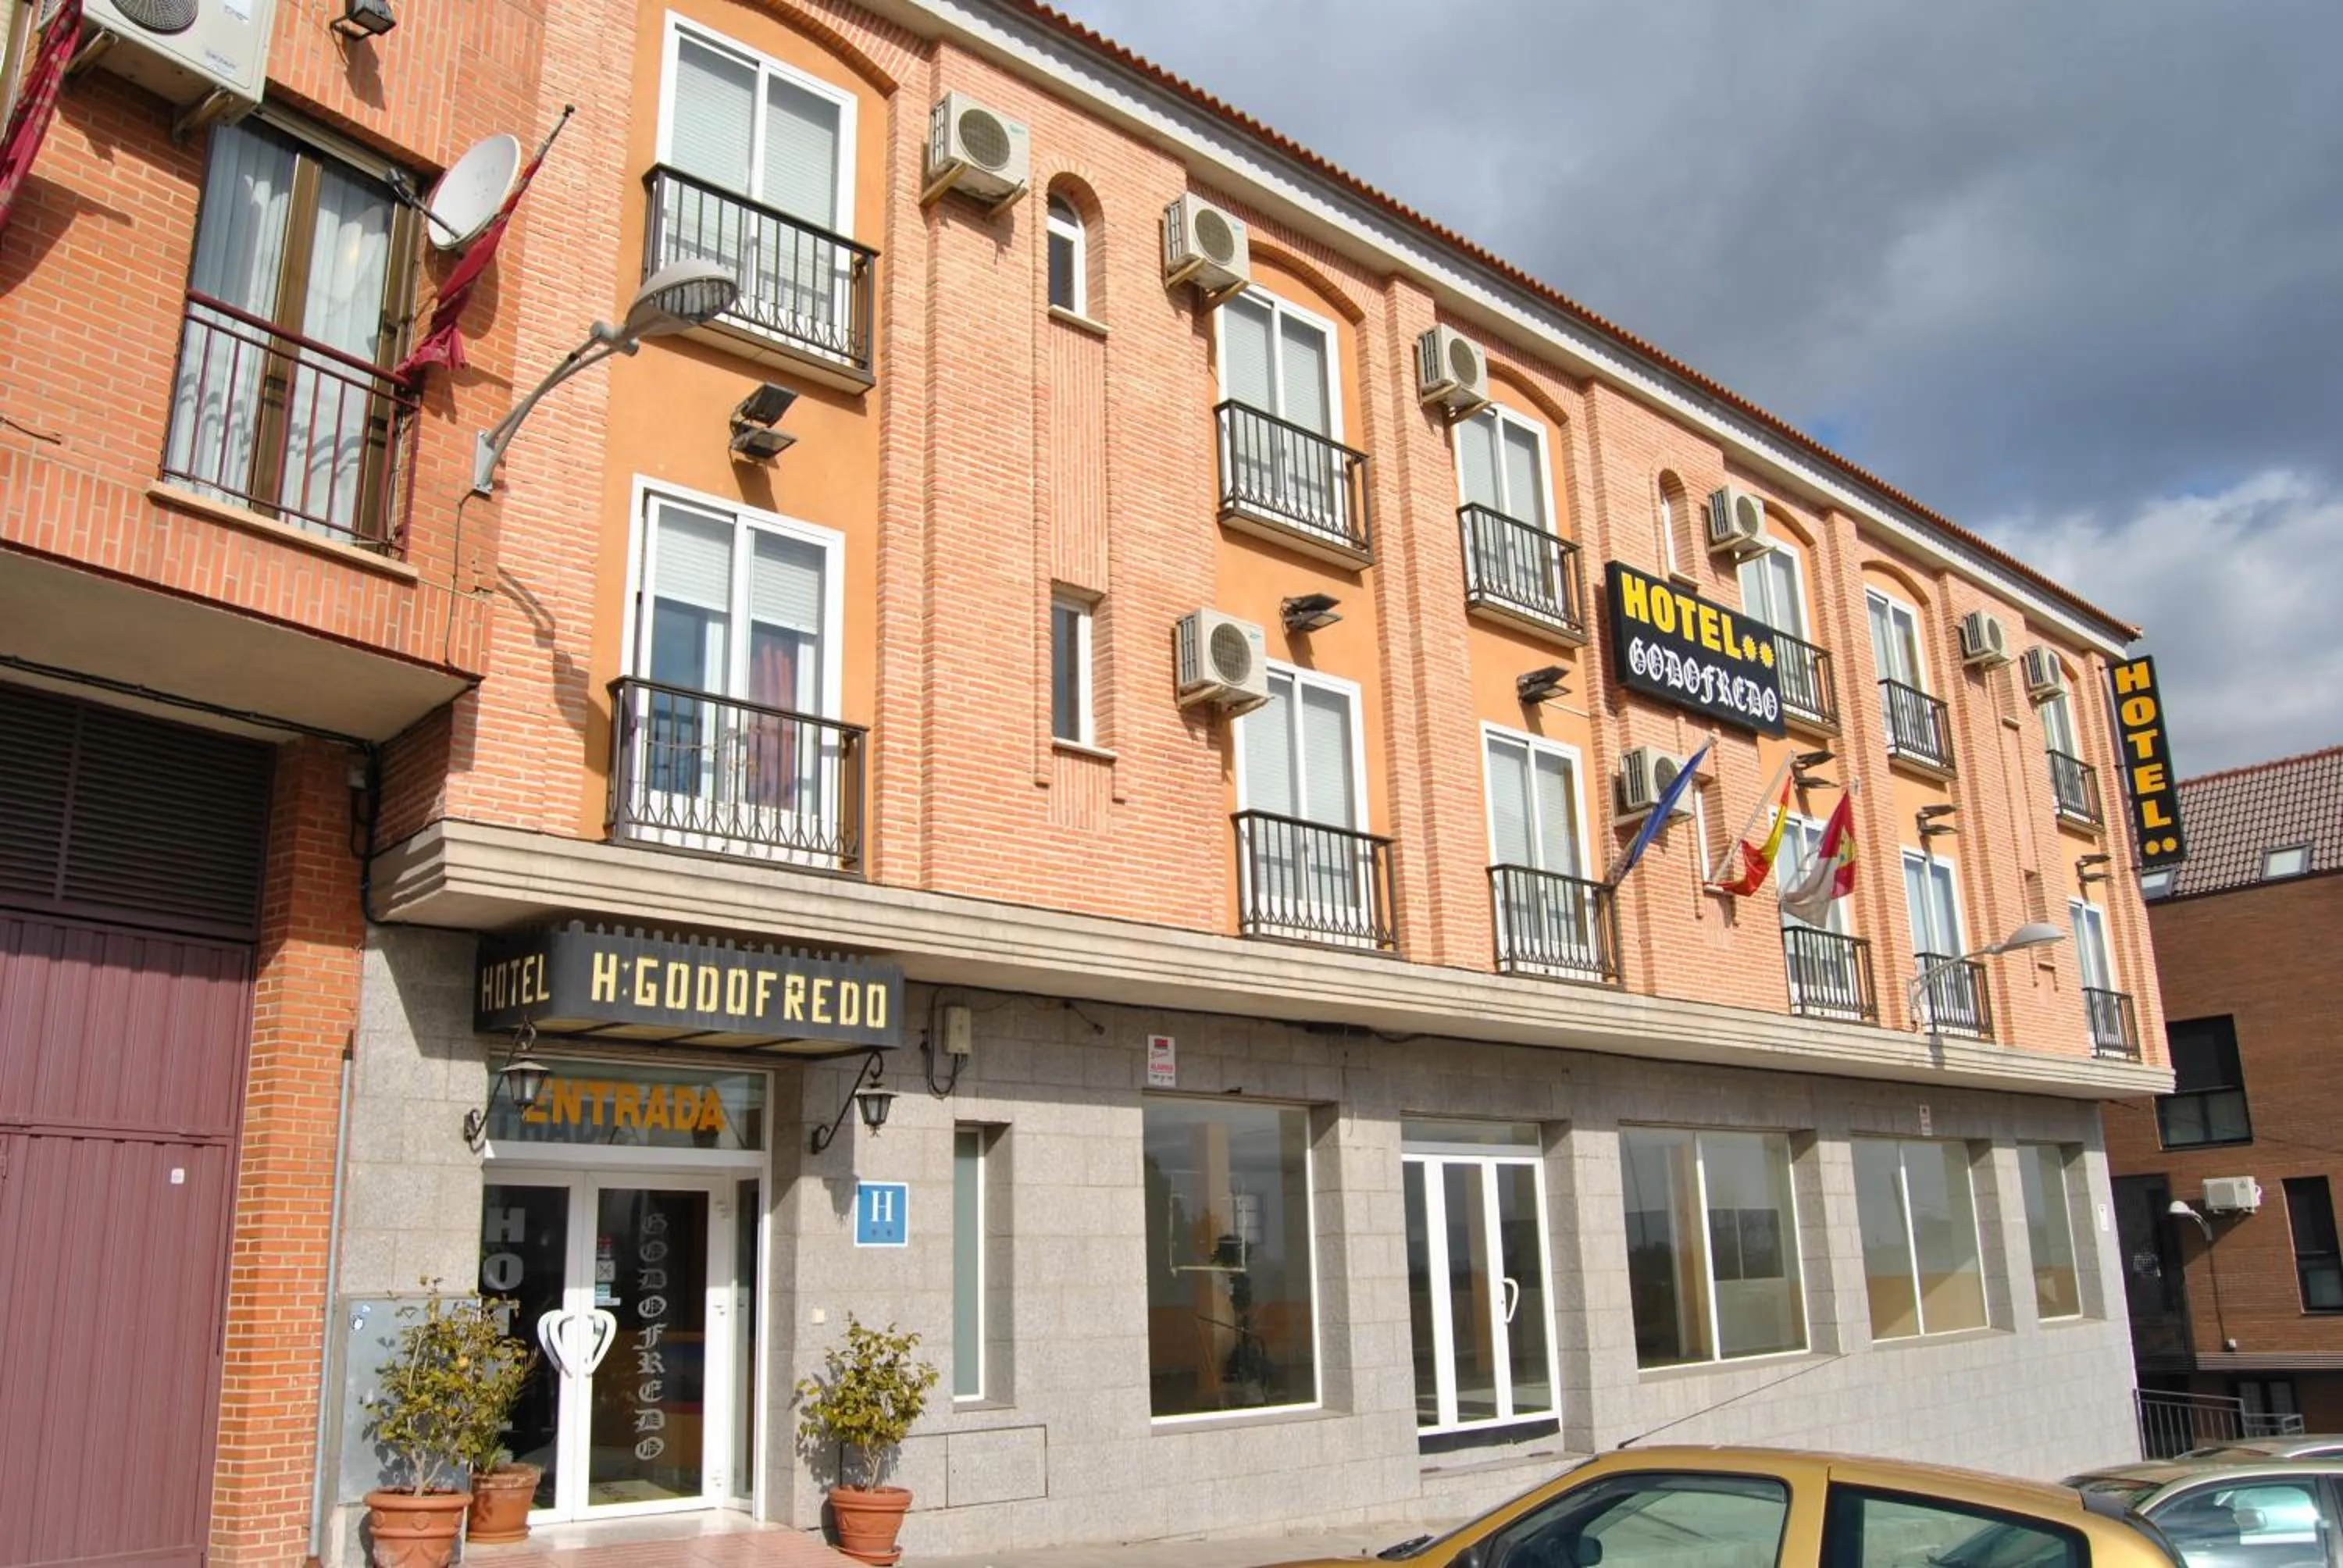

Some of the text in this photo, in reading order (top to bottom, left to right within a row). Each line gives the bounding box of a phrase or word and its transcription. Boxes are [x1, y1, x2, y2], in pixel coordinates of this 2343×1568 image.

[1621, 572, 1742, 661] HOTEL
[1629, 636, 1778, 722] GODOFREDO
[2114, 661, 2172, 829] HOTEL
[481, 953, 551, 1013] HOTEL
